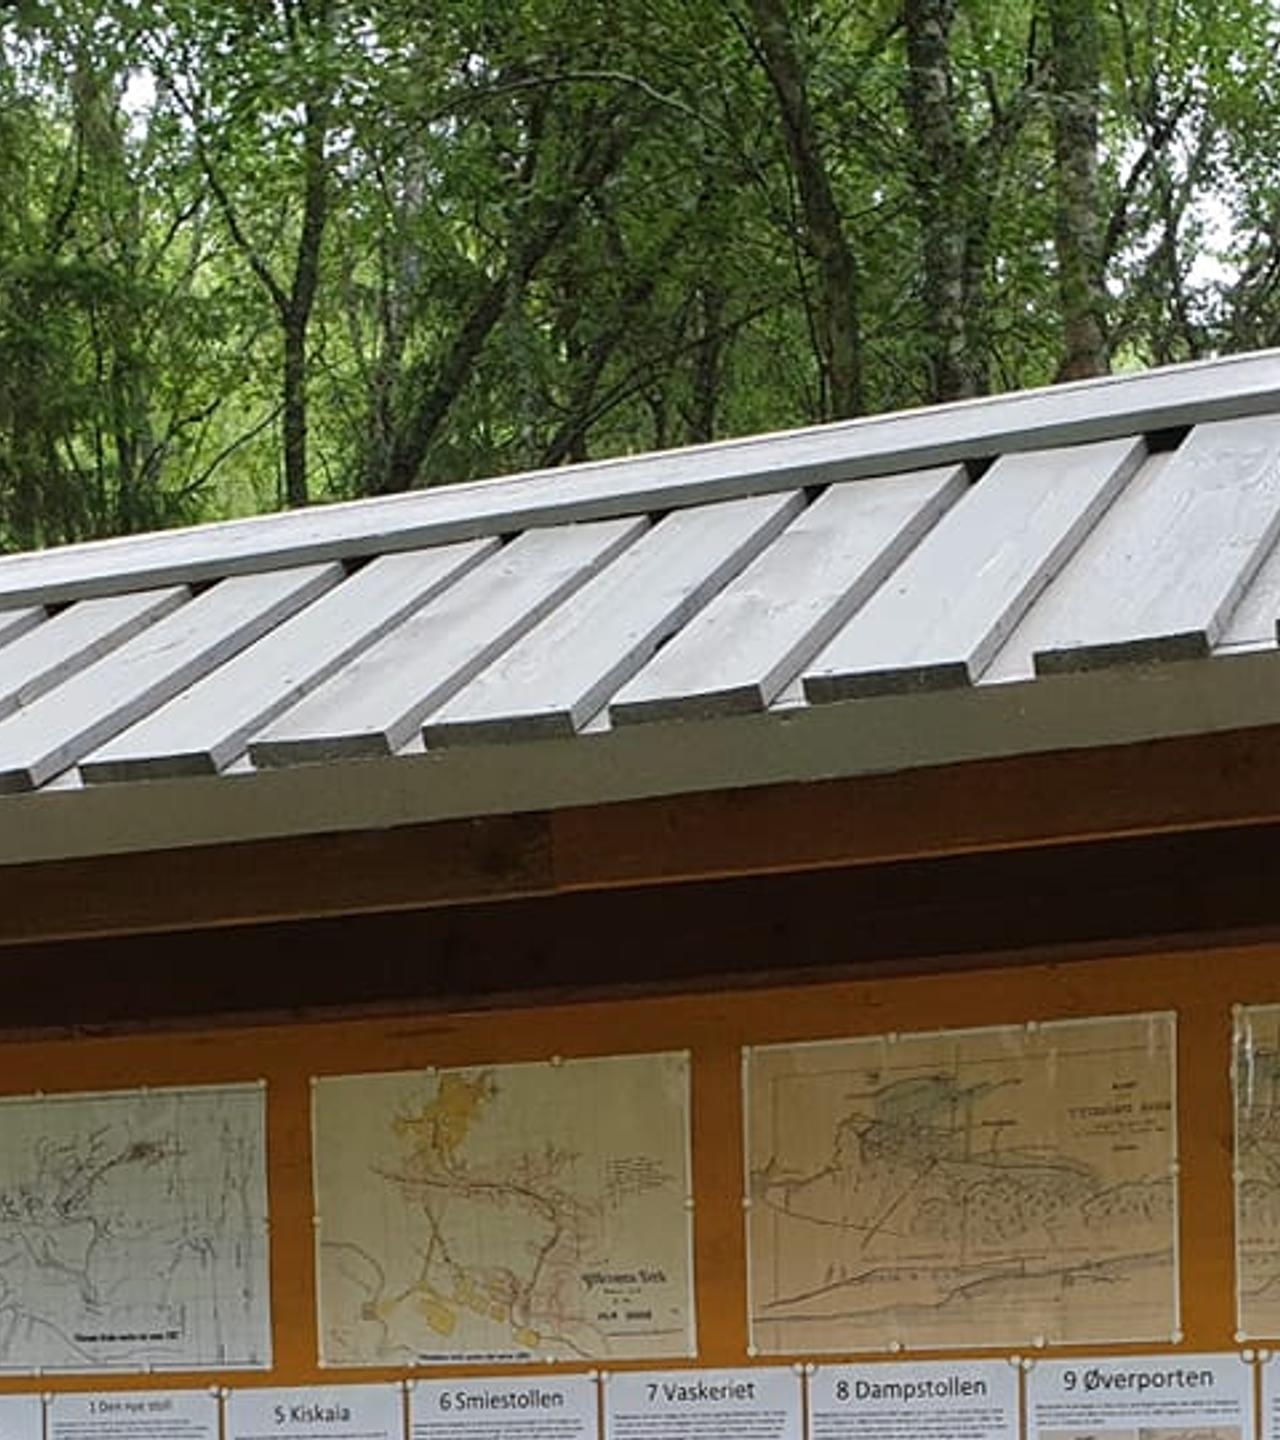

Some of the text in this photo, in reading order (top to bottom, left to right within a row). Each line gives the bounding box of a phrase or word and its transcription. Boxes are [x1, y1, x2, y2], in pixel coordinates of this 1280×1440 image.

[647, 1381, 756, 1402] 7 Vaskeriet
[836, 1376, 987, 1404] 8 Dampstollen
[1063, 1367, 1214, 1395] 9 Øverporten
[99, 1399, 122, 1413] Den
[439, 1388, 563, 1411] 6 Smiestollen
[274, 1402, 351, 1425] 5 Kiskaia
